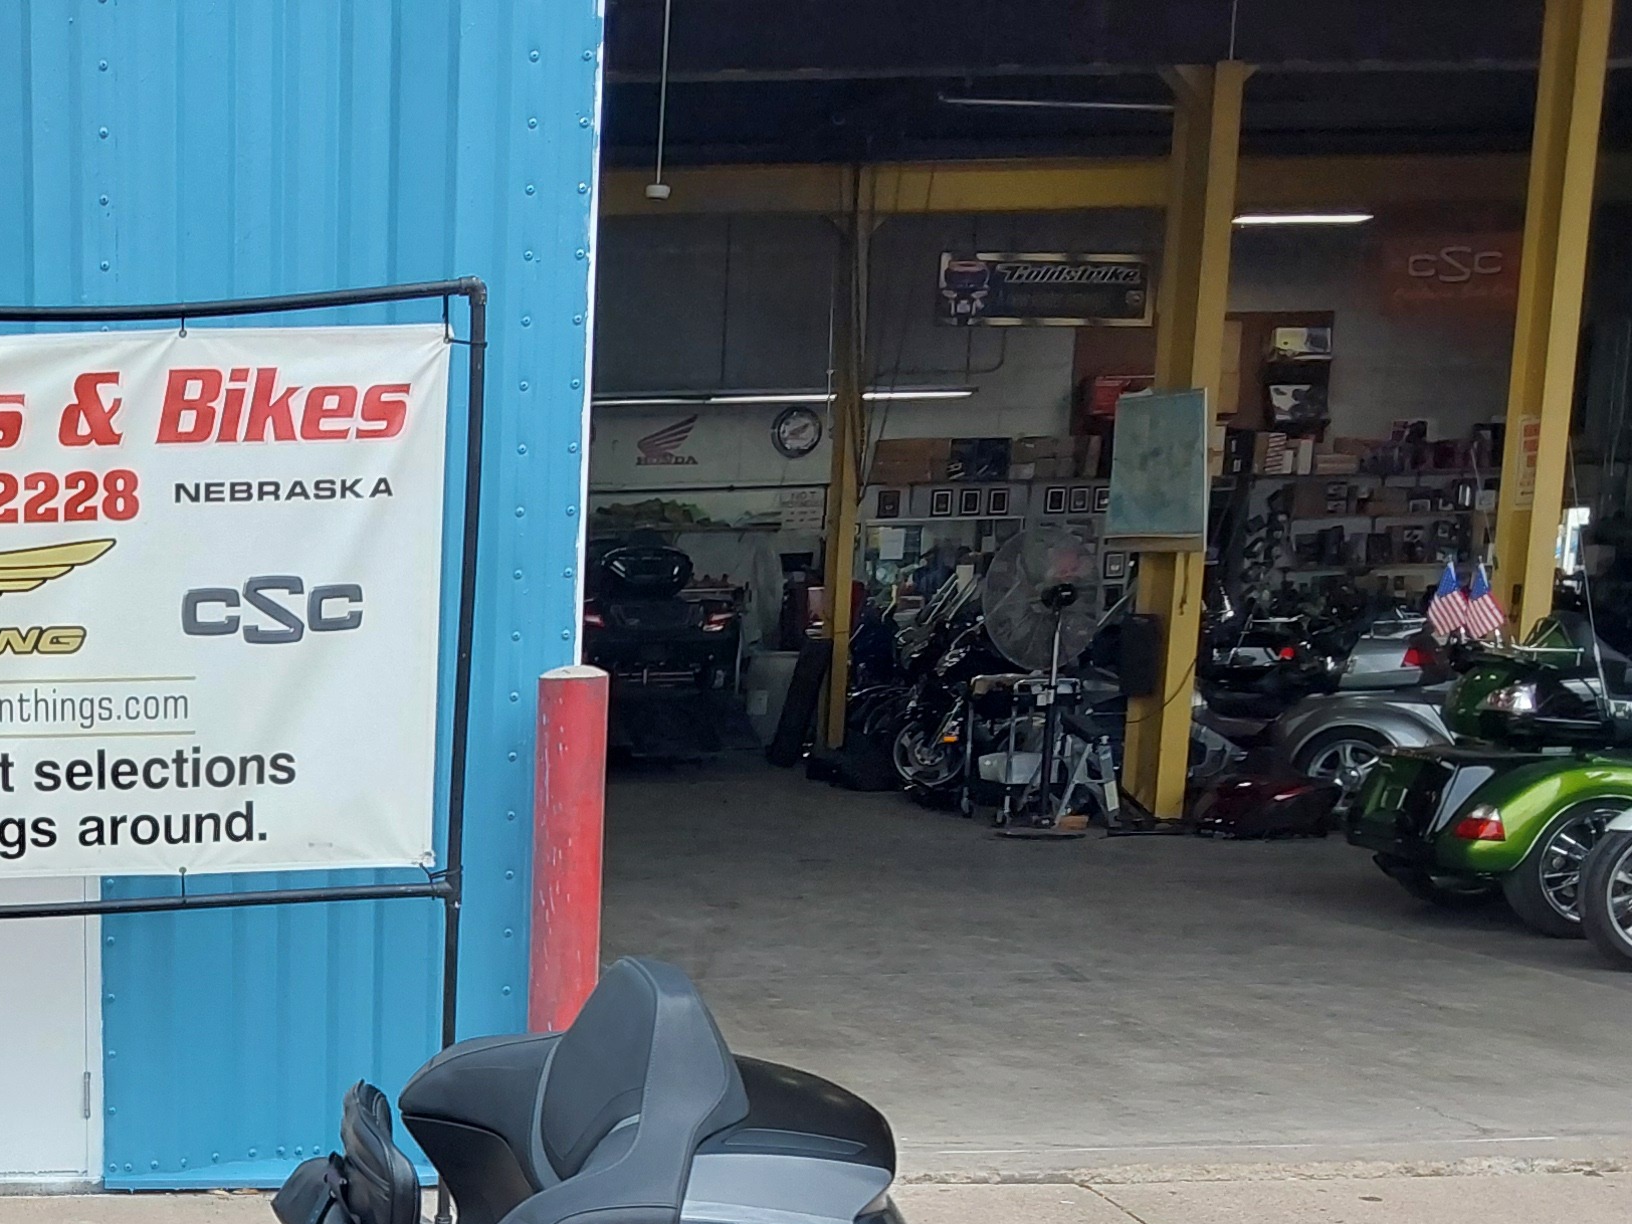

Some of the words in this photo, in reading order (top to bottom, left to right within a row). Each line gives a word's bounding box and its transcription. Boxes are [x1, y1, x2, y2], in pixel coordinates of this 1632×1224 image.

[57, 371, 124, 447] &
[154, 366, 413, 445] Bikes
[173, 476, 394, 504] NEBRASKA
[180, 574, 365, 645] CSC
[33, 745, 297, 792] selections
[77, 799, 268, 847] around.
